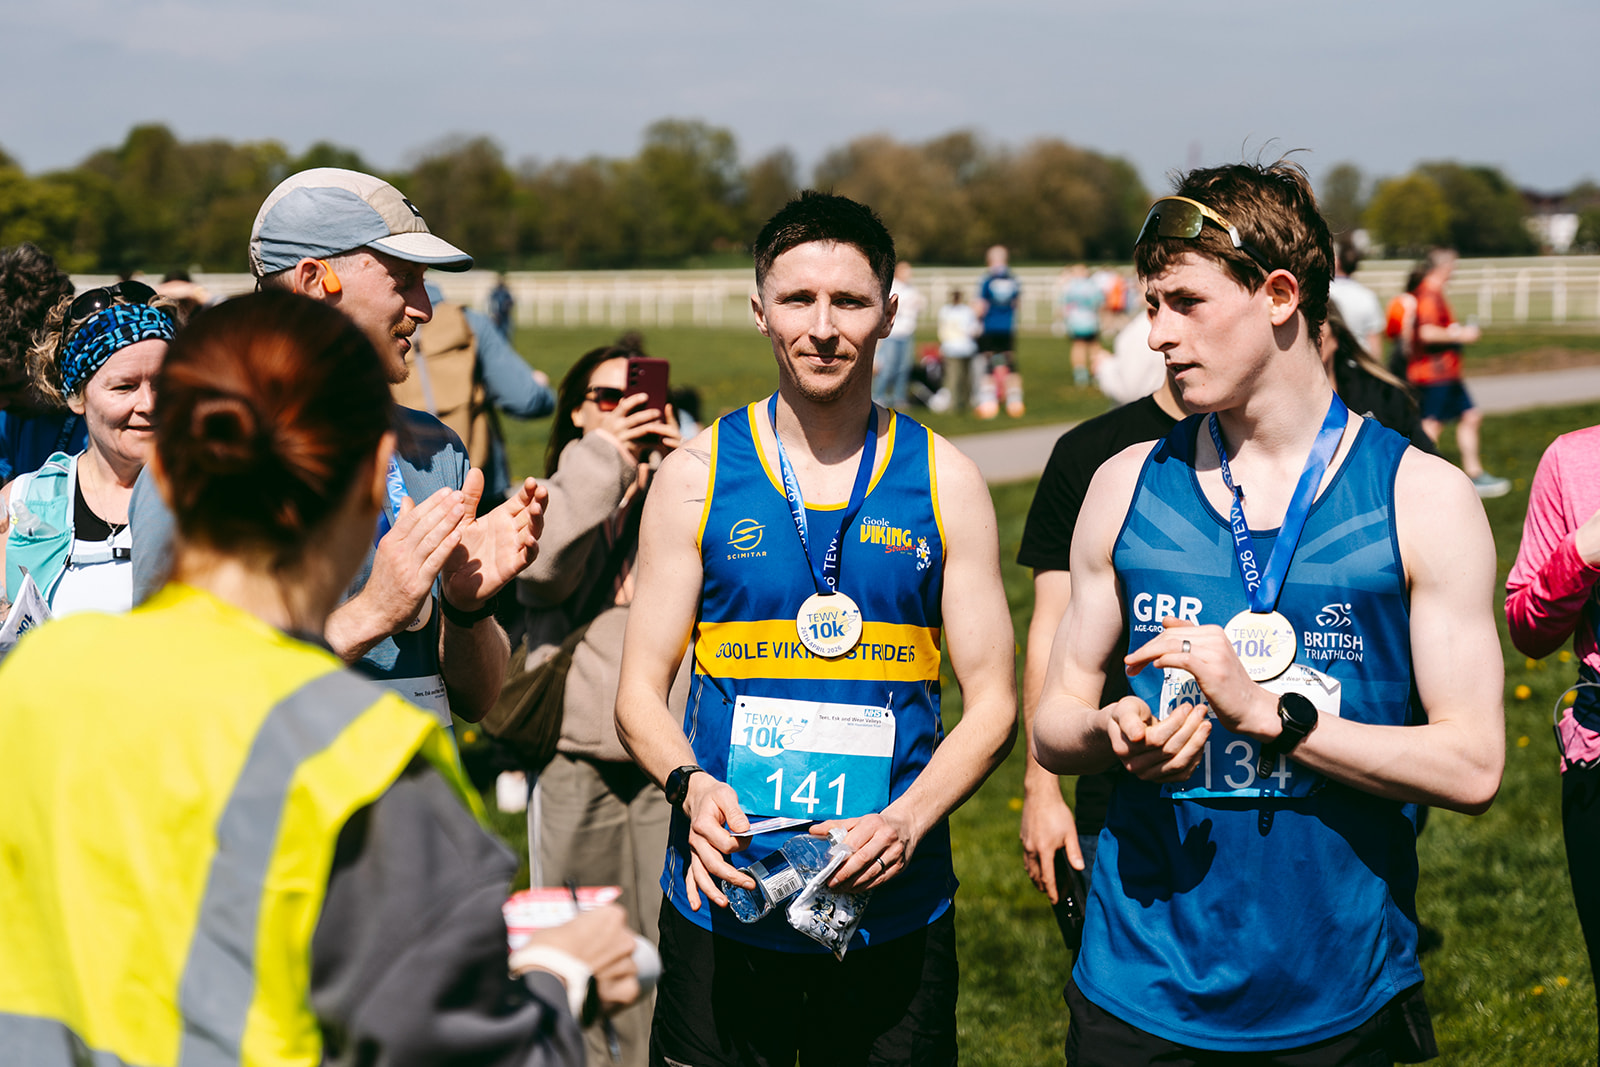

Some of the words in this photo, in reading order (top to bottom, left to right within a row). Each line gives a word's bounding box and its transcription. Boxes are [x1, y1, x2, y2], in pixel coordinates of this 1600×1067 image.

[862, 516, 890, 527] Goole
[1231, 498, 1249, 546] TEW
[860, 524, 913, 547] VIKING
[727, 551, 767, 560] SCIMITAR
[1240, 550, 1261, 593] 2026
[806, 611, 839, 623] TEWV
[1133, 592, 1203, 627] GBR
[808, 620, 846, 640] 10k
[1134, 624, 1165, 633] AGE-GRO
[1232, 629, 1268, 639] TEWV
[715, 641, 768, 660] GOOLE
[1232, 639, 1272, 658] 10k
[1304, 631, 1363, 651] BRITISH
[1304, 648, 1363, 662] TRIATHLON
[744, 712, 783, 727] TEWV
[864, 708, 882, 718] NHS
[742, 726, 786, 750] 10k
[766, 767, 846, 816] 141
